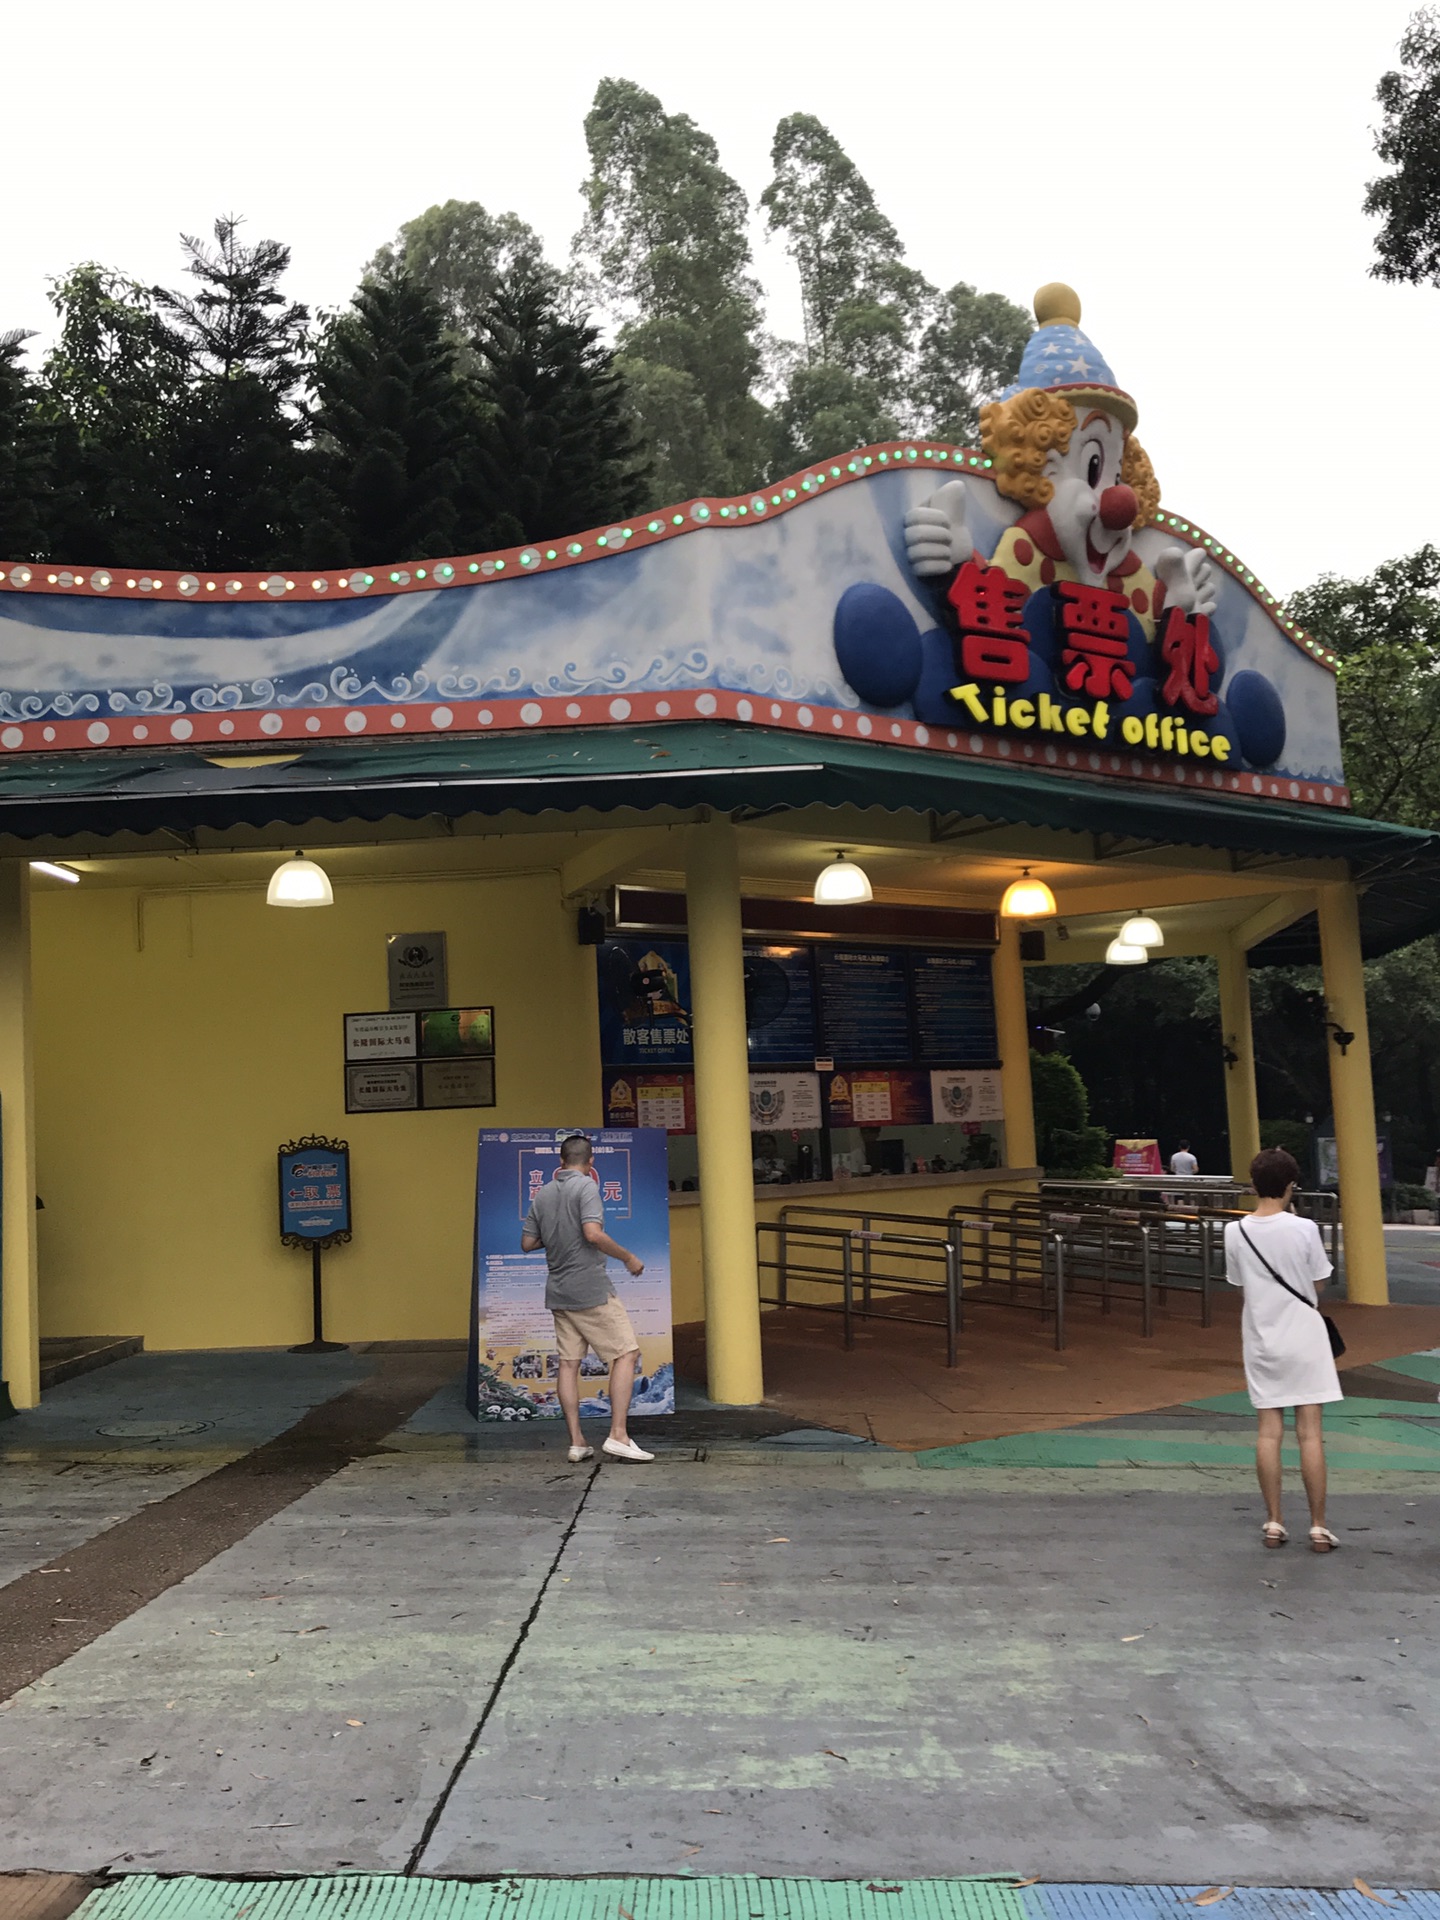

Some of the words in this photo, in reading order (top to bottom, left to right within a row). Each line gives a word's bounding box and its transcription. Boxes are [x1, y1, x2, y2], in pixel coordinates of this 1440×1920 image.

[948, 562, 1220, 716] 售票处
[950, 683, 1110, 739] Ticket
[622, 1028, 690, 1045] 散客售票处
[603, 1181, 622, 1201] 元
